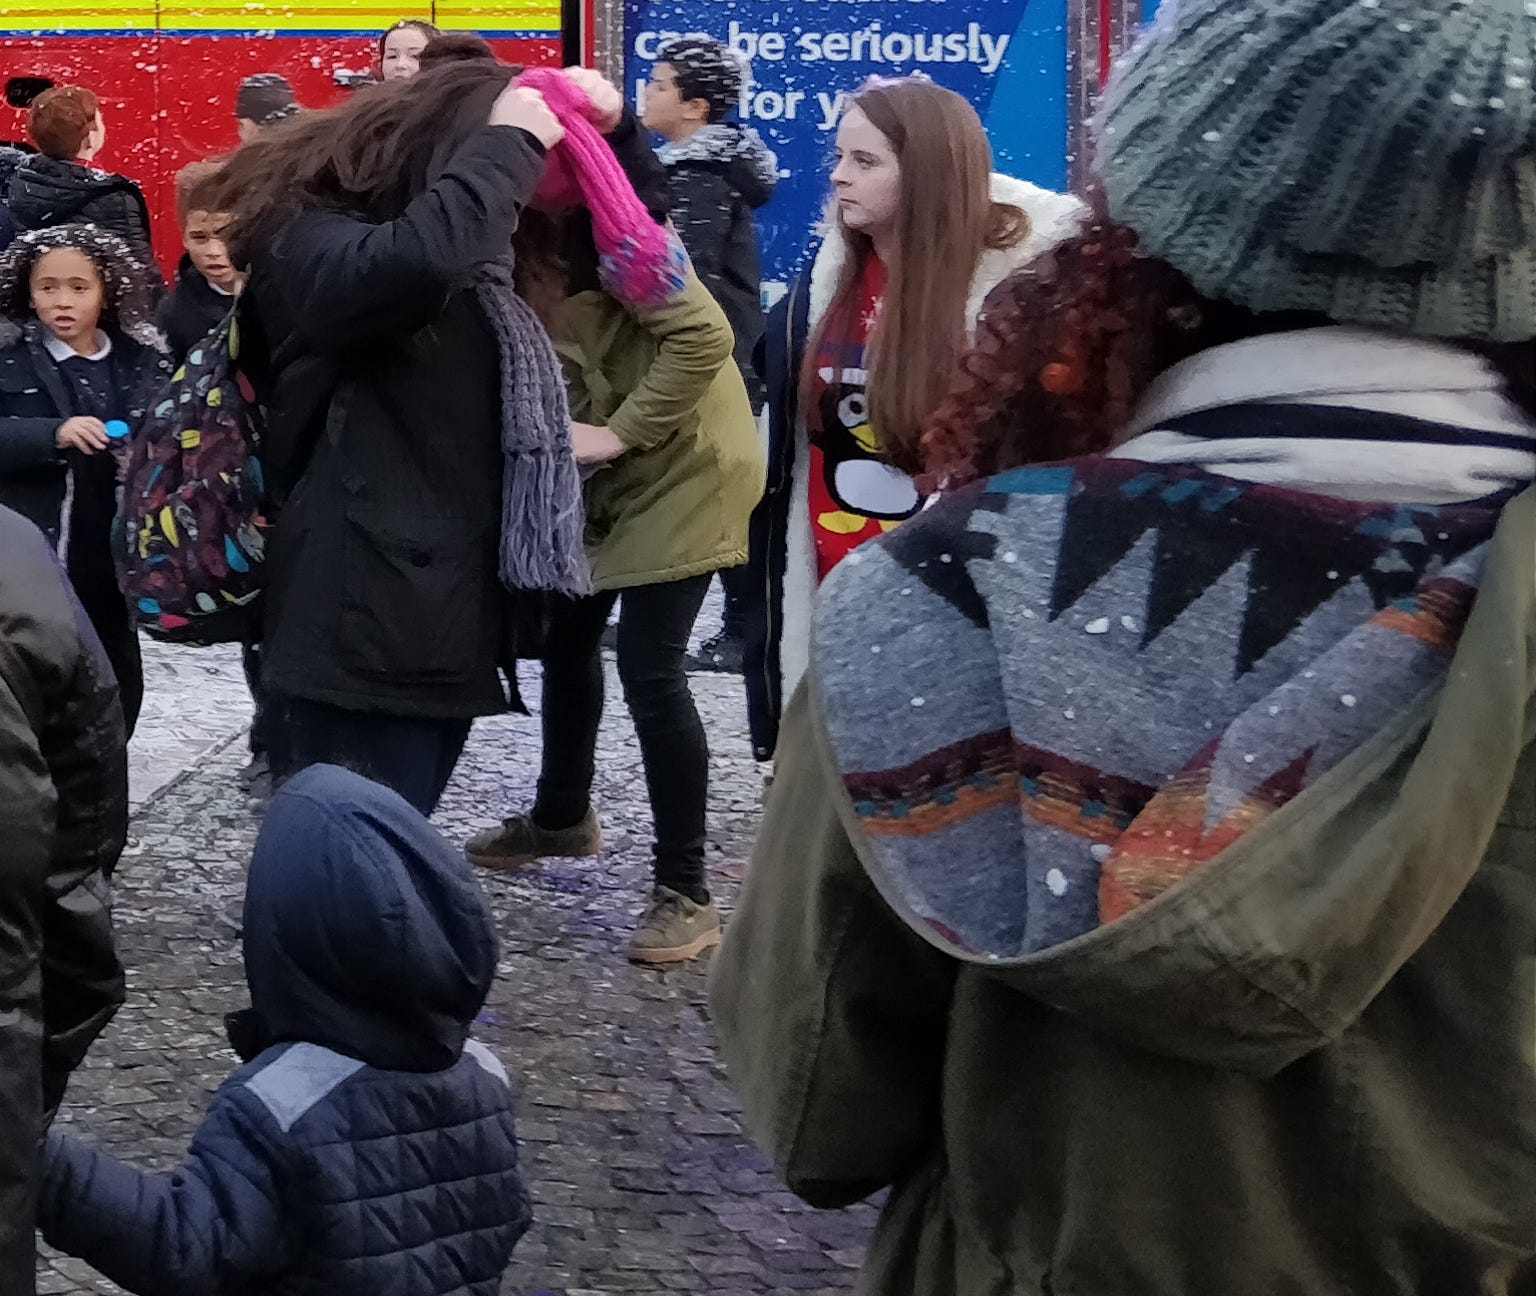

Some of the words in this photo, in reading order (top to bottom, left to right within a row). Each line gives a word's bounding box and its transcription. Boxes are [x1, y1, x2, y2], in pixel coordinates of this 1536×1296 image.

[729, 20, 786, 62] be
[800, 22, 1011, 73] seriously
[738, 77, 806, 120] for
